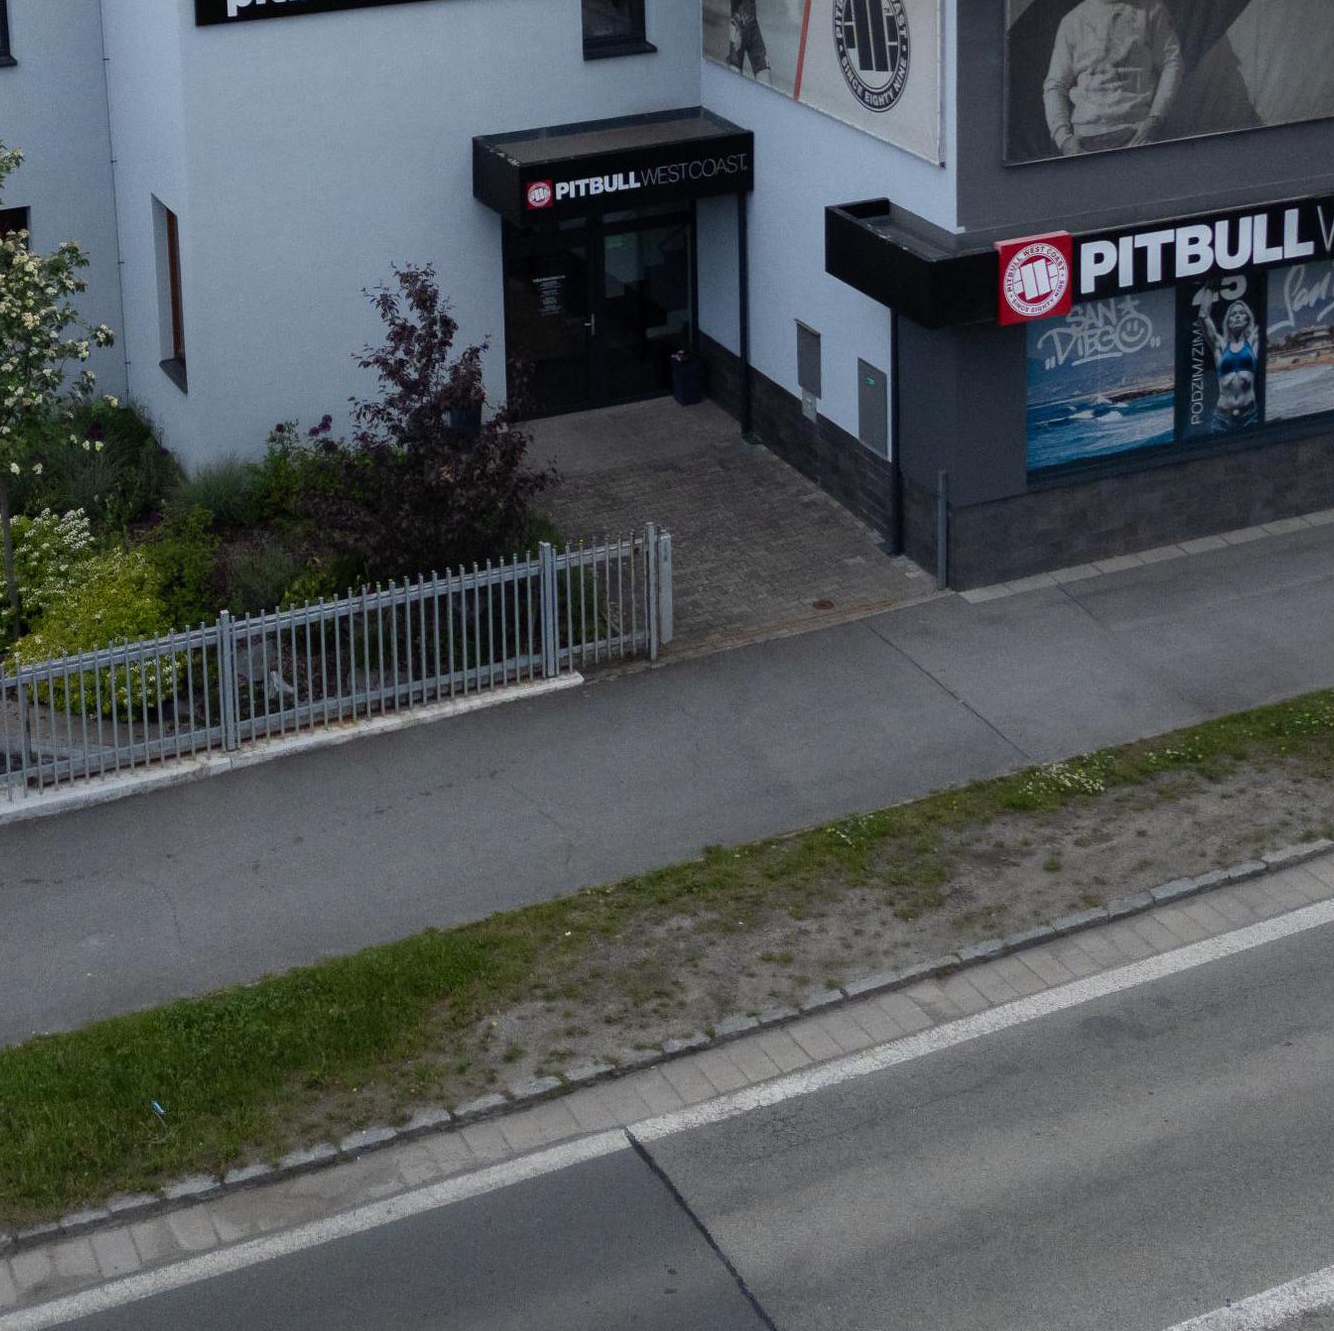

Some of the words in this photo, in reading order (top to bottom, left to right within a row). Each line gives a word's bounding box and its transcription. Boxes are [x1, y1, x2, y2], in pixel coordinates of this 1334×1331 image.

[841, 55, 864, 99] SINCE
[864, 89, 895, 107] EIGHTY
[893, 56, 908, 93] NINE
[555, 171, 642, 201] PITBULL
[1080, 207, 1316, 295] PITBULL
